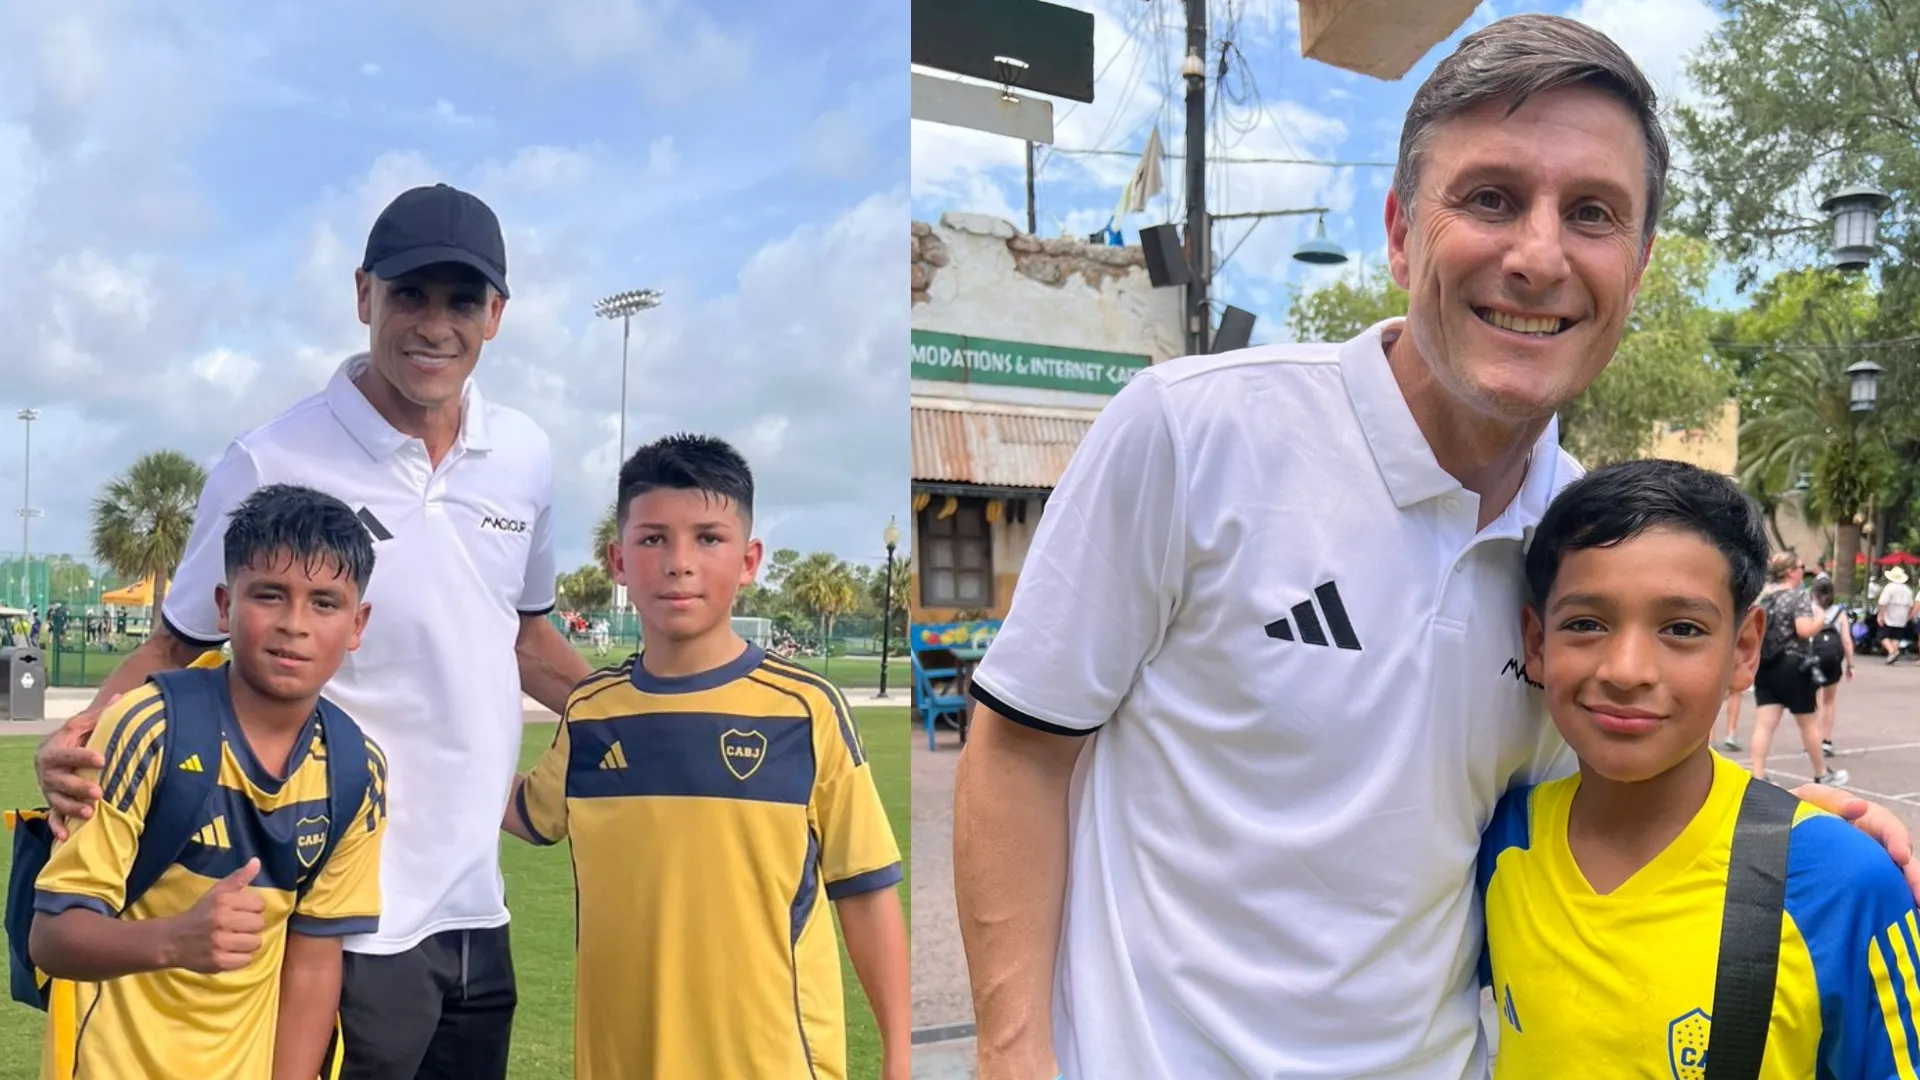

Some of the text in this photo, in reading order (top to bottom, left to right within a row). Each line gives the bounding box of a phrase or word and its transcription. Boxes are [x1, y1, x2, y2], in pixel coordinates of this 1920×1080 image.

[911, 343, 1012, 375] MODATIONS
[1015, 355, 1029, 375] &
[1030, 357, 1104, 382] INTERNET
[726, 745, 760, 758] CABJ
[298, 832, 325, 846] CABJ
